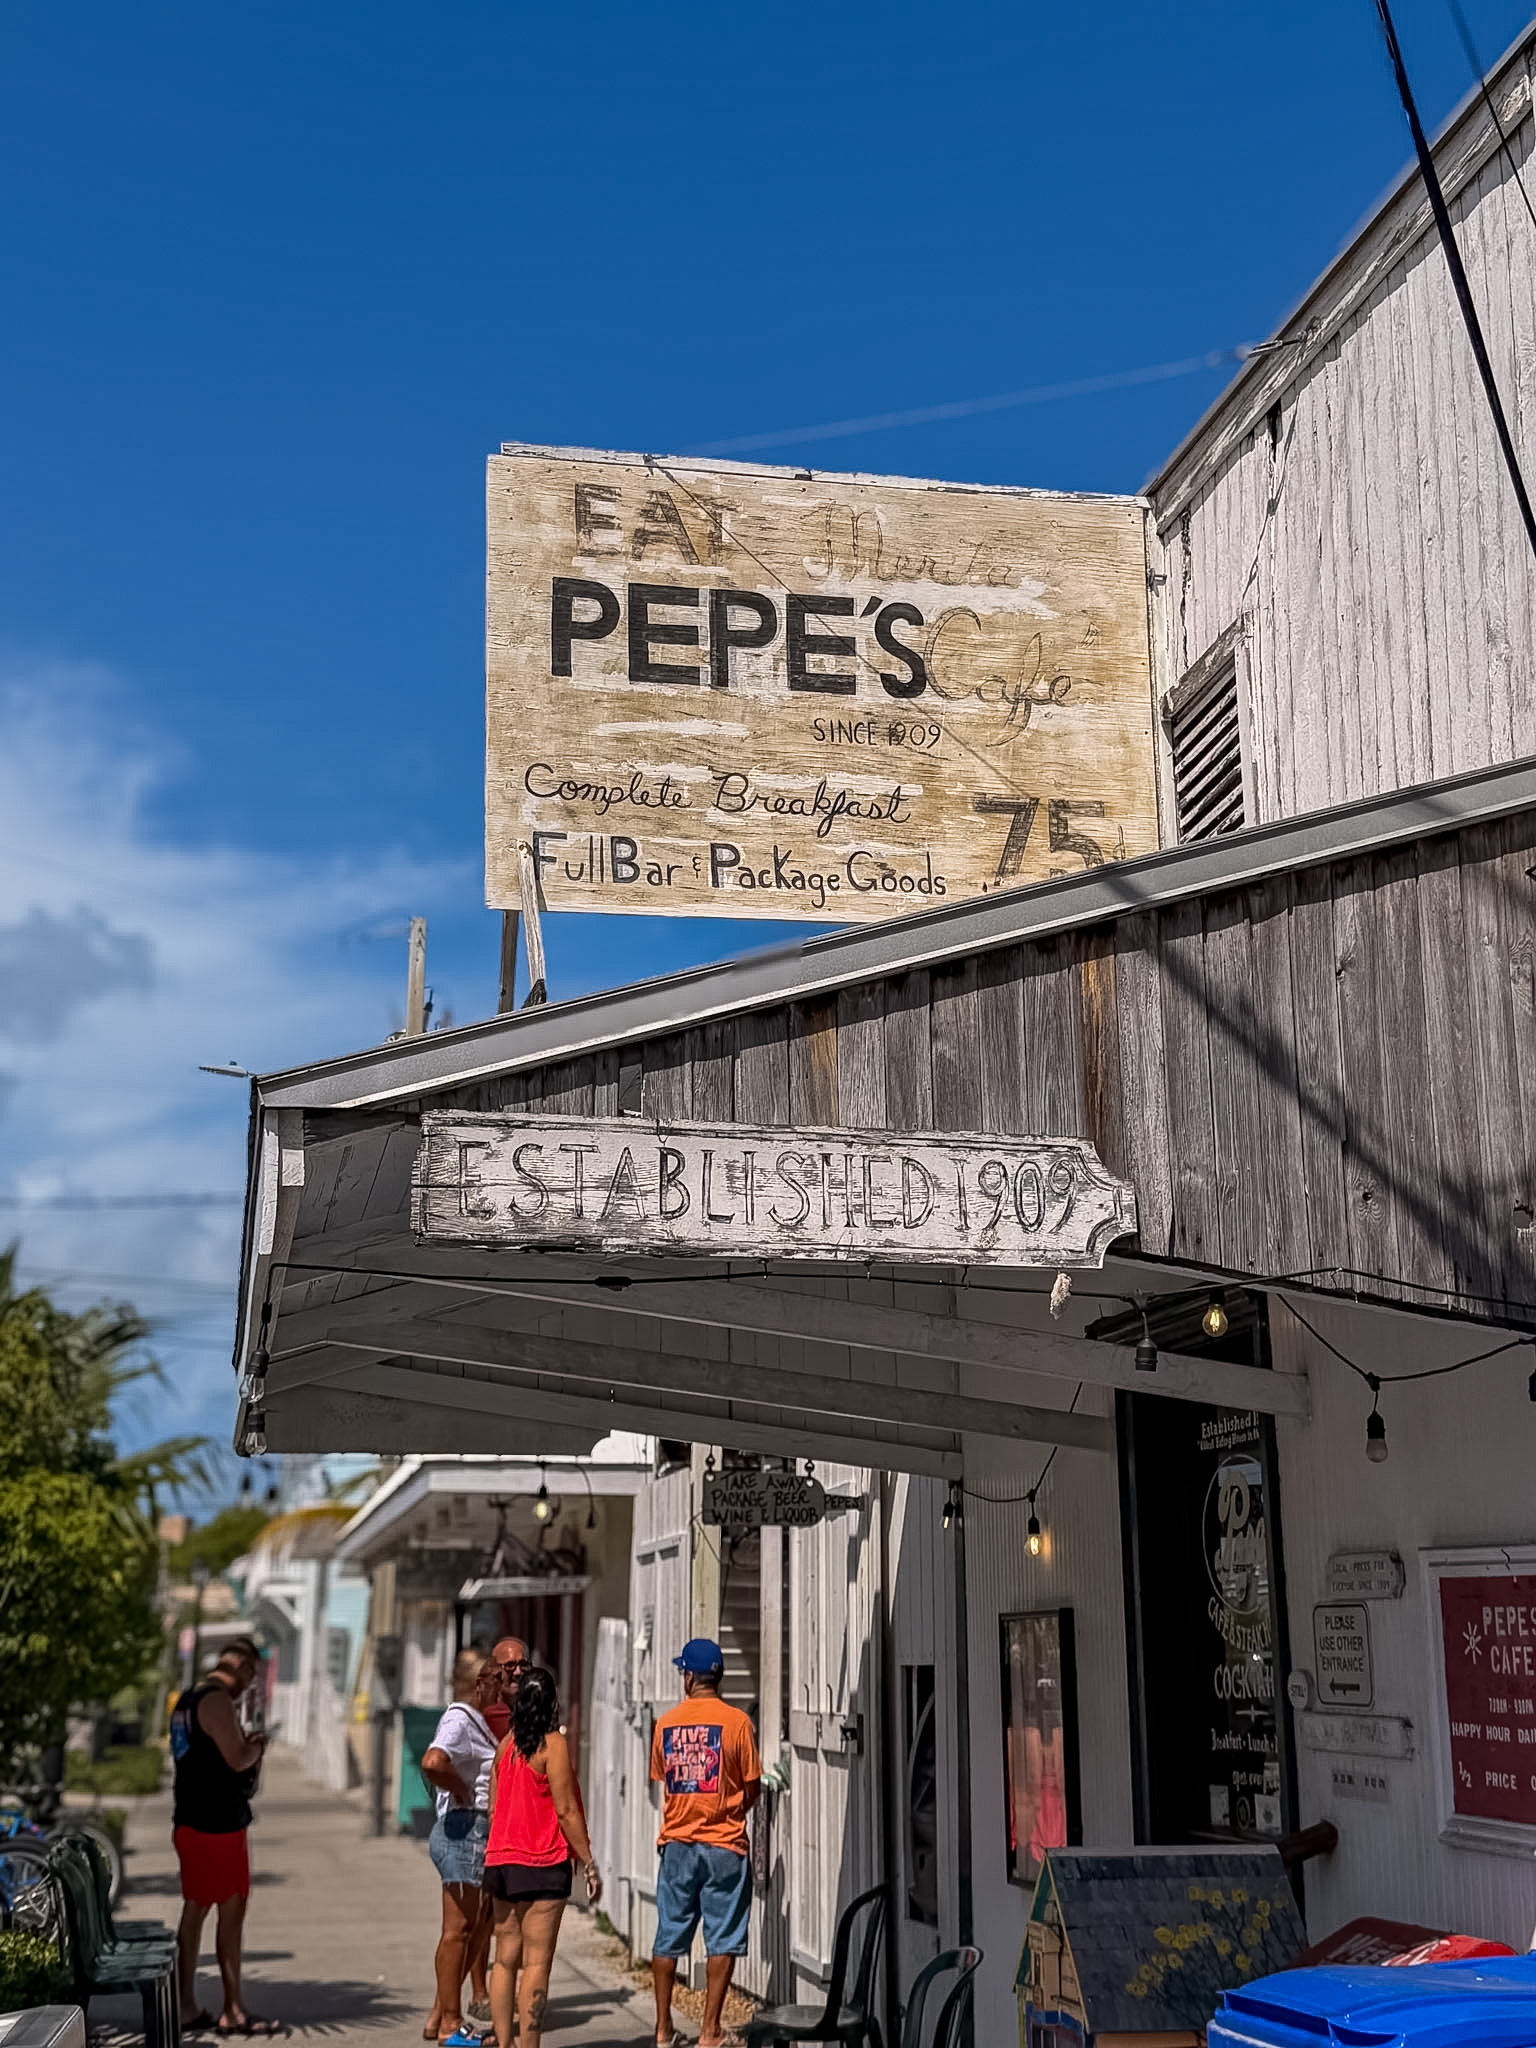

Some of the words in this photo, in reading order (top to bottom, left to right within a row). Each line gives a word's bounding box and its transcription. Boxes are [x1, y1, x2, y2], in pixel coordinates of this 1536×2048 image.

[574, 483, 742, 567] EAT
[551, 577, 926, 699] PEPE'S
[812, 717, 877, 746] SINCE
[888, 722, 942, 750] 1909
[525, 763, 693, 816] Complete
[711, 766, 911, 838] Breakfast
[457, 1139, 935, 1231] ESTABLISHED
[949, 1157, 1078, 1235] 1909
[1201, 1411, 1252, 1440] Established
[720, 1471, 758, 1490] TAKE
[766, 1474, 804, 1492] AWAY
[711, 1489, 768, 1508] PACKAGE
[773, 1489, 811, 1506] BEER
[711, 1508, 753, 1525] WINE
[773, 1507, 819, 1524] LIQUOR
[1324, 1614, 1356, 1631] PLEASE
[1319, 1635, 1336, 1652] USE
[1336, 1635, 1364, 1652] OTHER
[1320, 1655, 1364, 1673] ENTRANCE
[1490, 1645, 1535, 1676] CAFE
[1451, 1720, 1482, 1739] HAPPY
[1485, 1725, 1511, 1743] HOUR
[1485, 1770, 1518, 1790] PRICE
